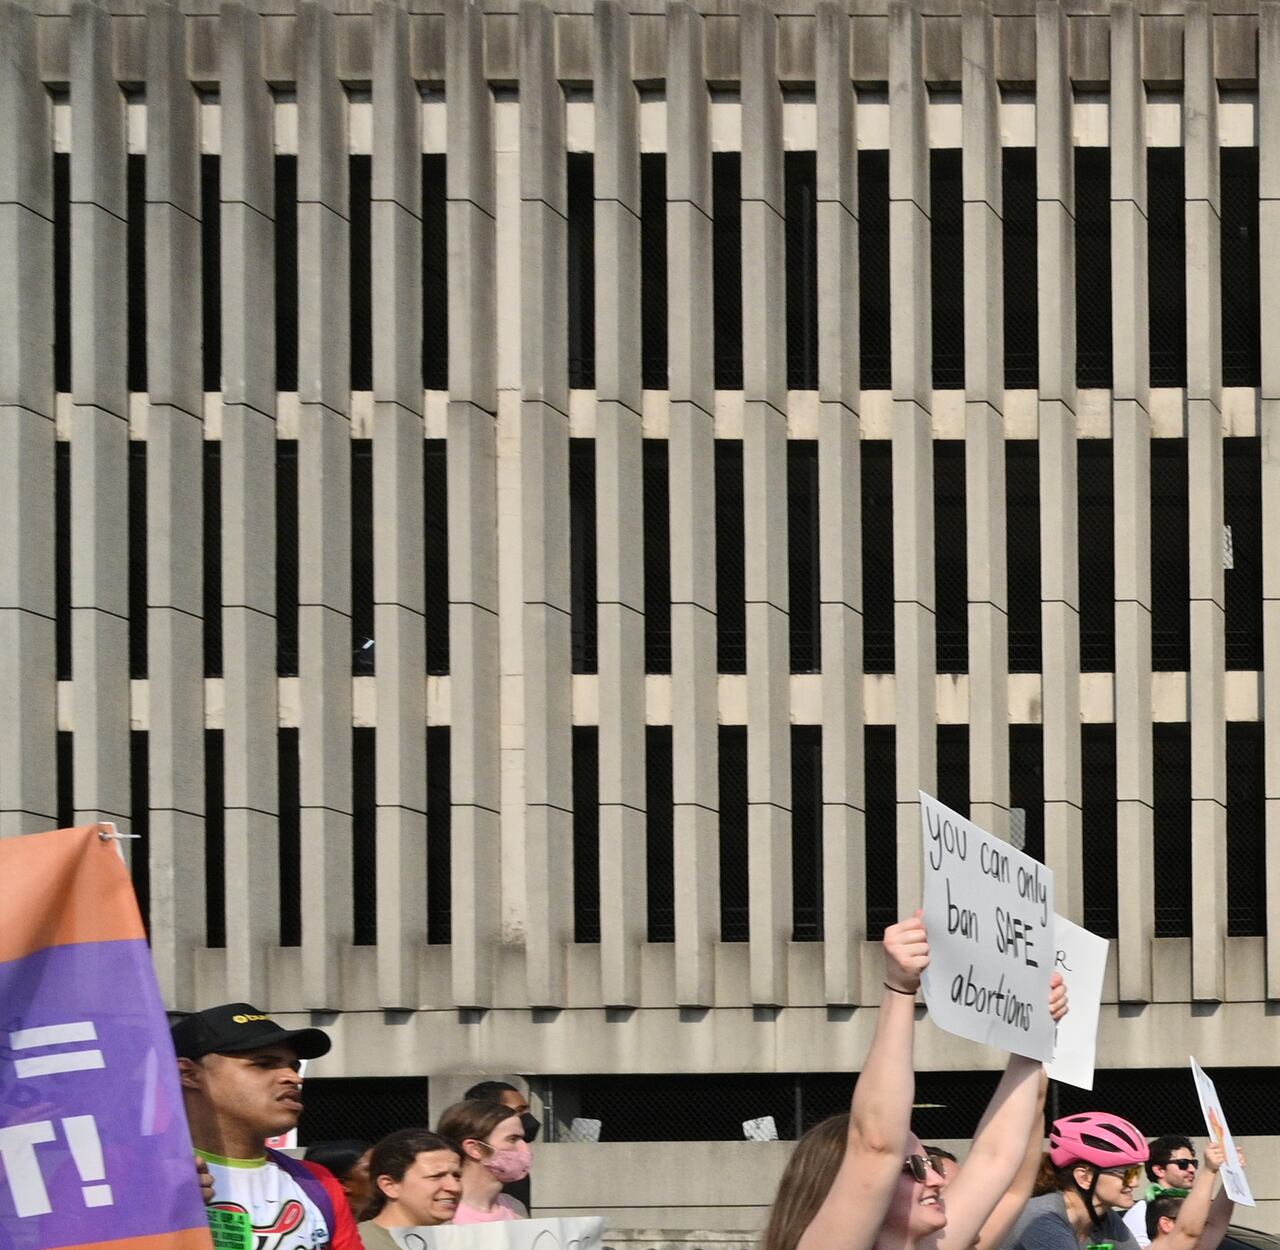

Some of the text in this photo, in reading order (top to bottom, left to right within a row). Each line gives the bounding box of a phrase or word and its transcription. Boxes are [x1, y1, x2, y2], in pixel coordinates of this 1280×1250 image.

[926, 806, 1047, 927] you can only
[946, 878, 1039, 968] ban SAFE
[951, 964, 1033, 1032] abortions
